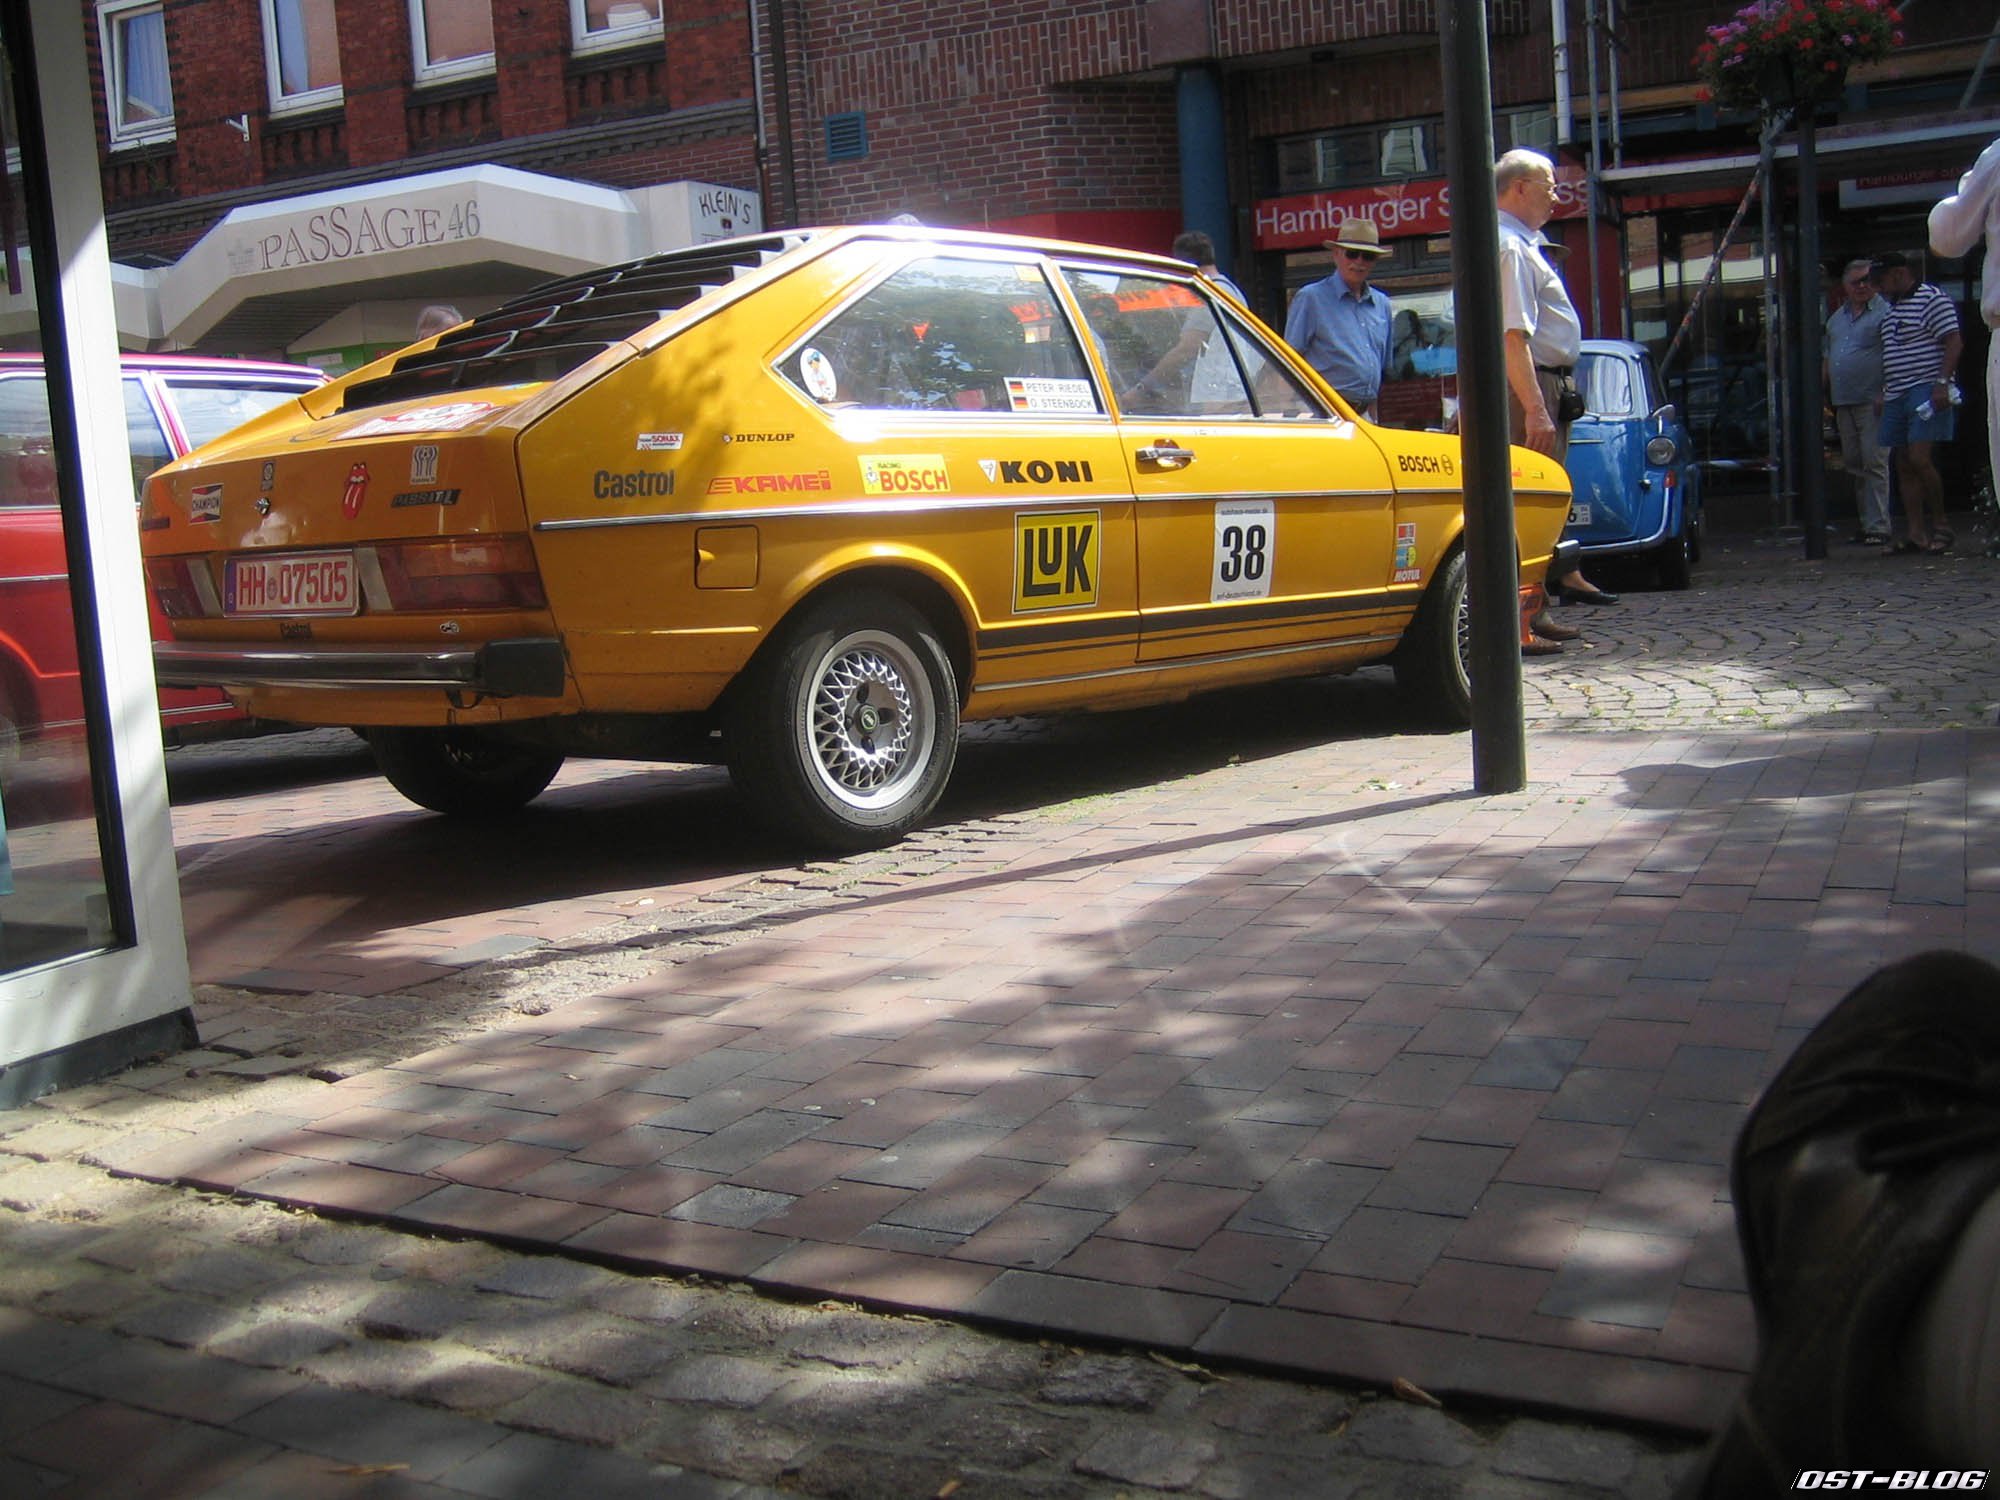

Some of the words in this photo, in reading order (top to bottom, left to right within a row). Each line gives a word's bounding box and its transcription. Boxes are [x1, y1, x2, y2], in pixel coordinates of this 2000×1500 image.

[699, 191, 751, 225] KLEIN'S
[1256, 196, 1430, 236] Hamburger
[258, 206, 445, 270] PASSAGE
[448, 199, 481, 239] 46
[1026, 383, 1054, 393] PETER
[1041, 398, 1094, 409] STEENBOCK
[736, 433, 795, 443] DUNLOP
[1000, 460, 1094, 483] KONI
[1398, 455, 1440, 473] BOSCH
[594, 469, 675, 499] Castrol
[879, 470, 948, 491] BOSCH
[191, 496, 220, 512] CHAMPION
[1220, 525, 1266, 582] 38
[239, 564, 266, 606] HH
[280, 561, 348, 605] 07505
[1394, 569, 1421, 581] MOTUL
